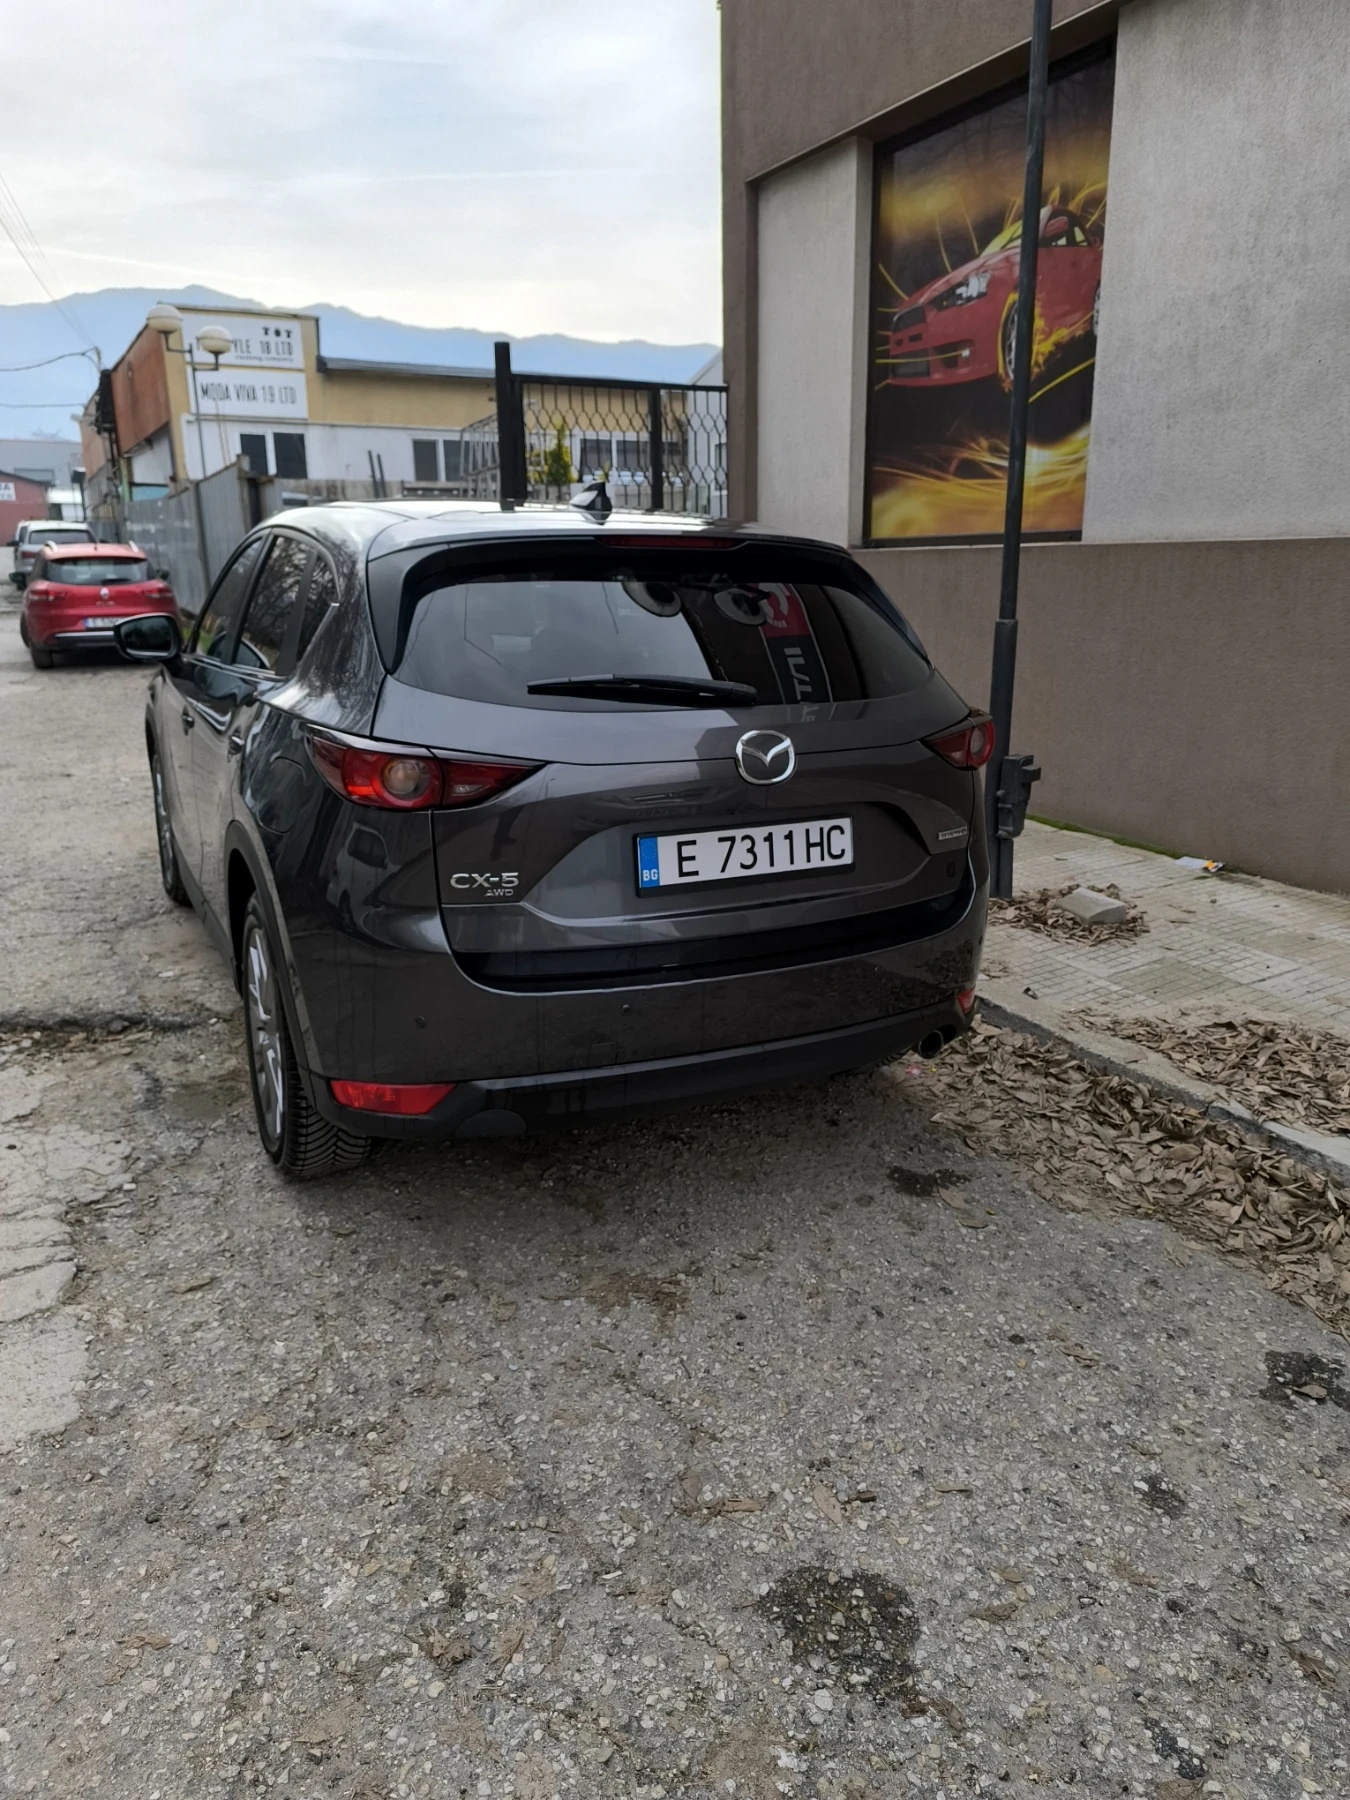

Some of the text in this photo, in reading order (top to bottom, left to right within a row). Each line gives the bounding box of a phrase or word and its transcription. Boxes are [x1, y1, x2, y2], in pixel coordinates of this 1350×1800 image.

[275, 341, 294, 357] LTD
[201, 382, 297, 405] MODA VIVA 19 LTD
[676, 824, 846, 878] E 7311HC
[450, 872, 519, 889] CX-5
[642, 868, 658, 882] BG
[484, 888, 514, 897] AWD
